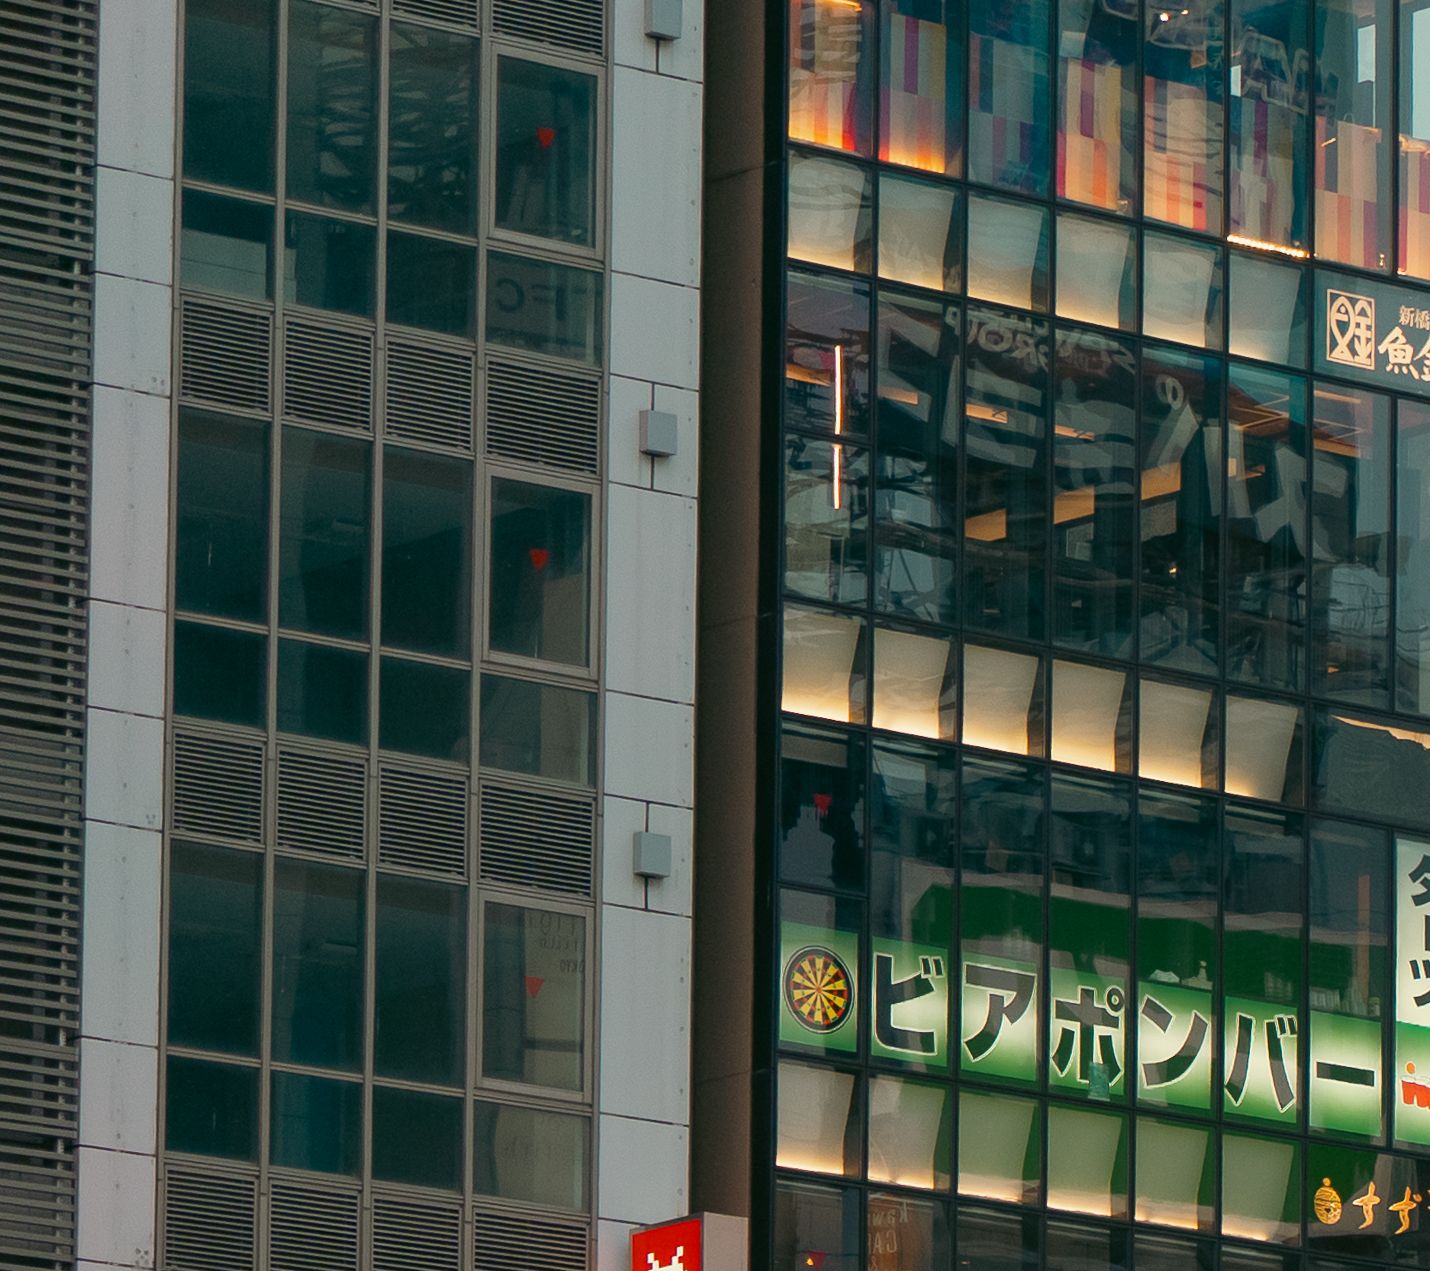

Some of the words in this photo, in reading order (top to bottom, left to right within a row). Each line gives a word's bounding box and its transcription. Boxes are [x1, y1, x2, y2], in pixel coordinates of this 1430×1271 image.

[1399, 303, 1430, 331] 新橋
[872, 953, 1376, 1113] ビアポンバー
